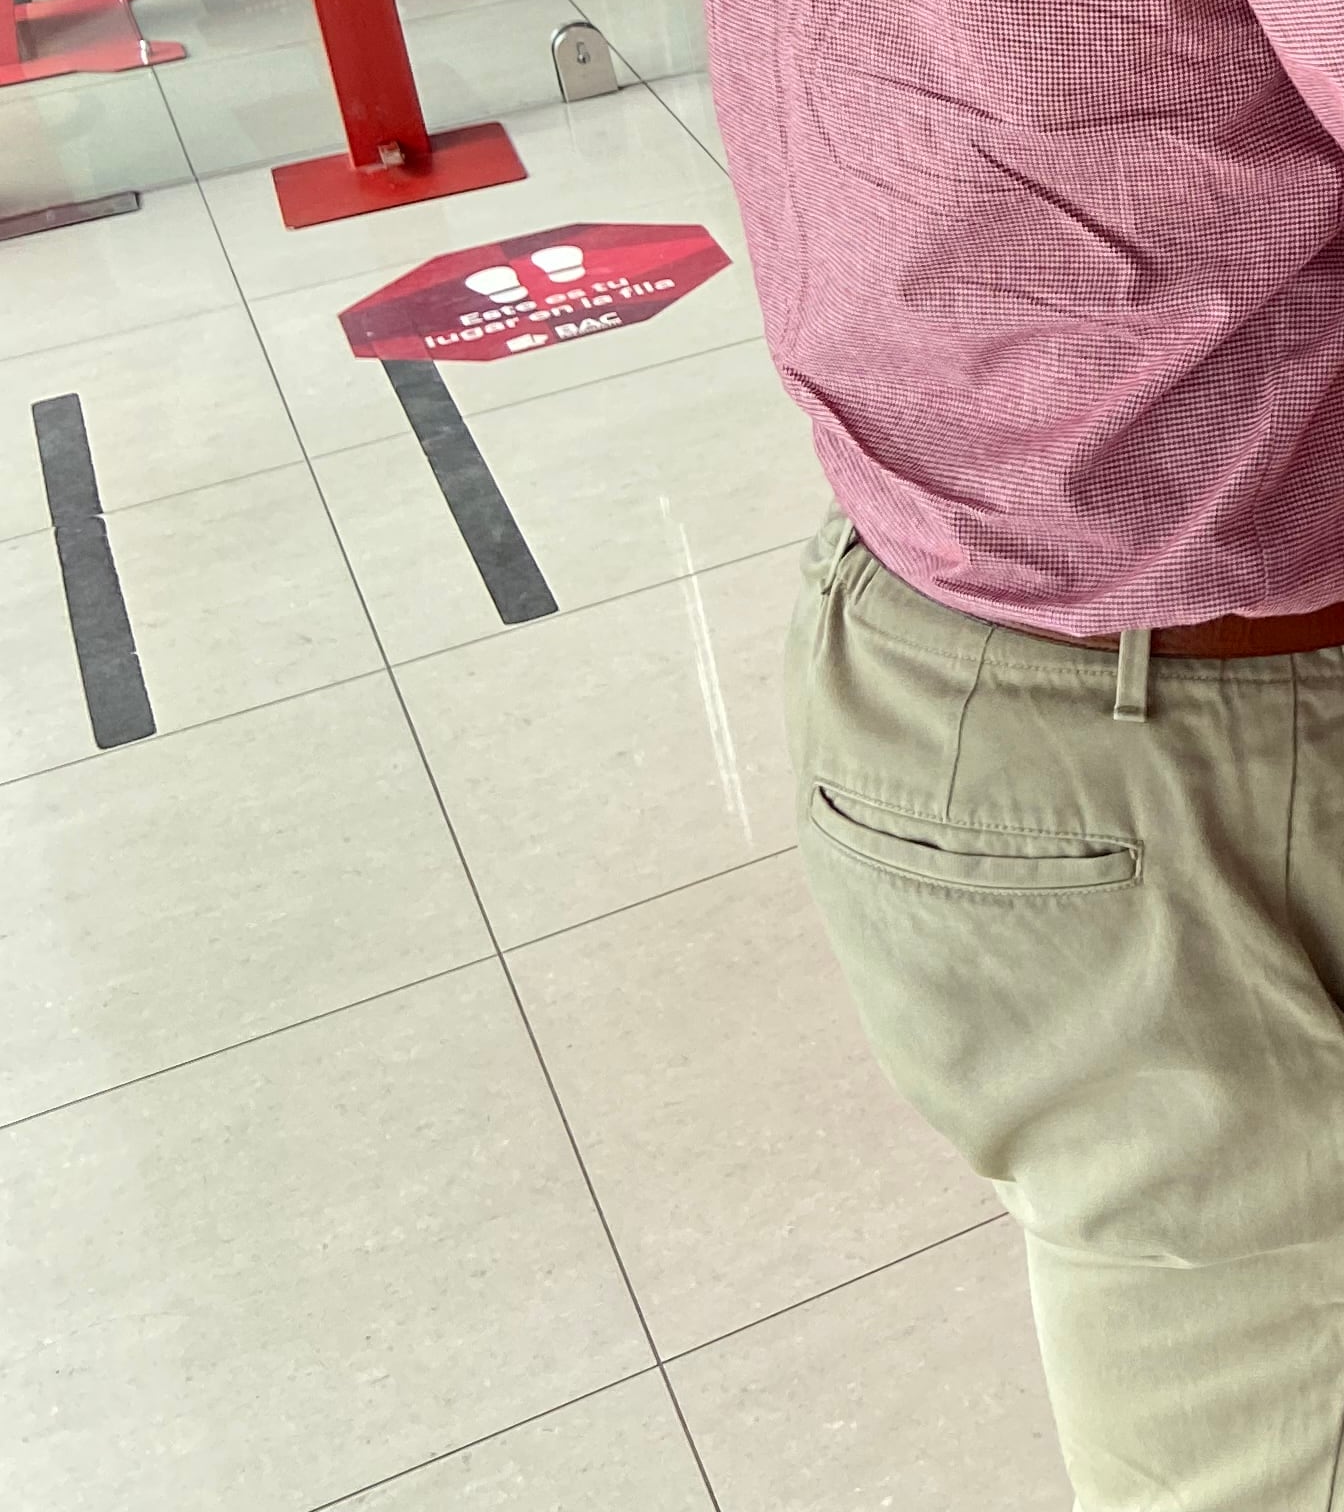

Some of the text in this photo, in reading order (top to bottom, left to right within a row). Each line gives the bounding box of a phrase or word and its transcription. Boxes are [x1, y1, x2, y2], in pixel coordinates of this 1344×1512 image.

[424, 278, 676, 349] lugar en la fila
[459, 278, 629, 327] Este es tu
[554, 311, 623, 339] BAC
